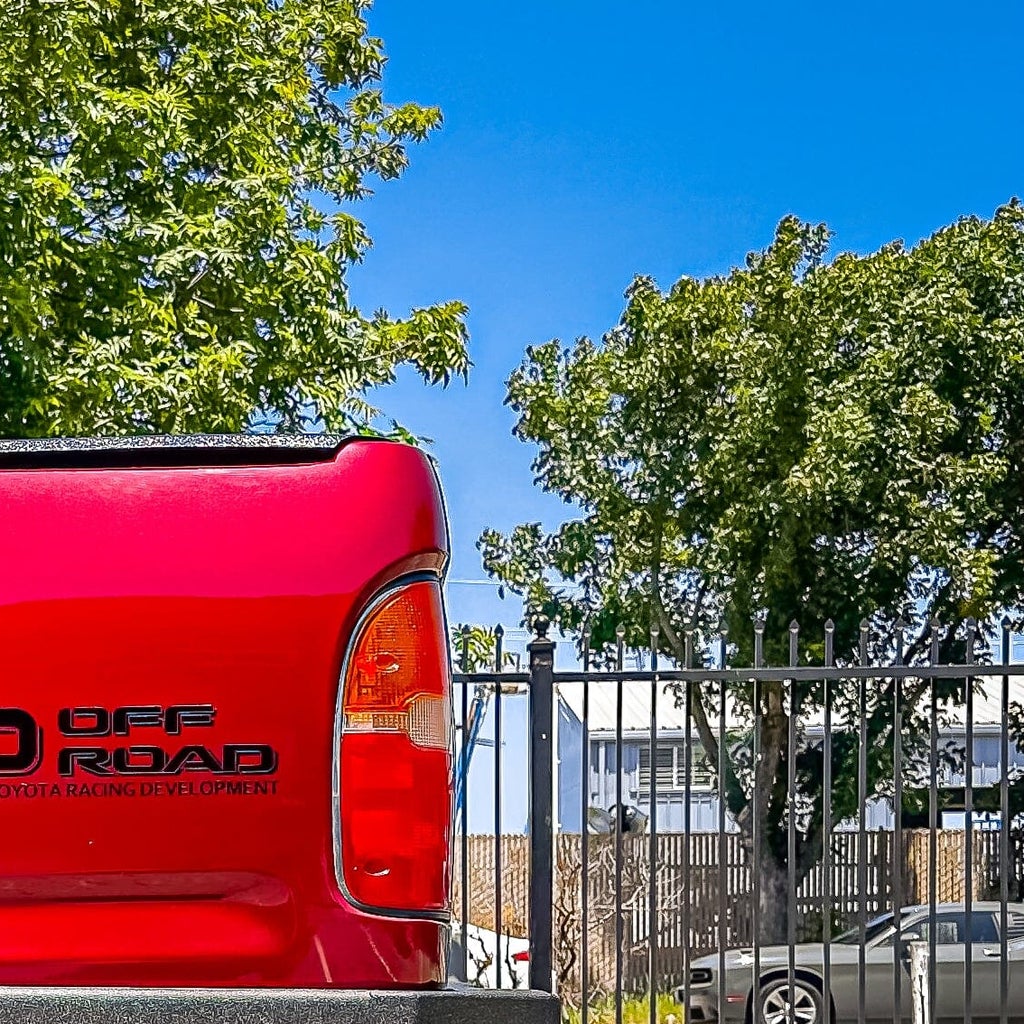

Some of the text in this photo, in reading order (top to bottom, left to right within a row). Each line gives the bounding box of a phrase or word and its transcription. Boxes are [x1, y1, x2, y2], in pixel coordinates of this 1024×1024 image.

[57, 704, 219, 737] OFF
[57, 743, 279, 777] ROAD
[66, 781, 135, 797] RACING
[140, 779, 279, 797] DEVELOPMENT
